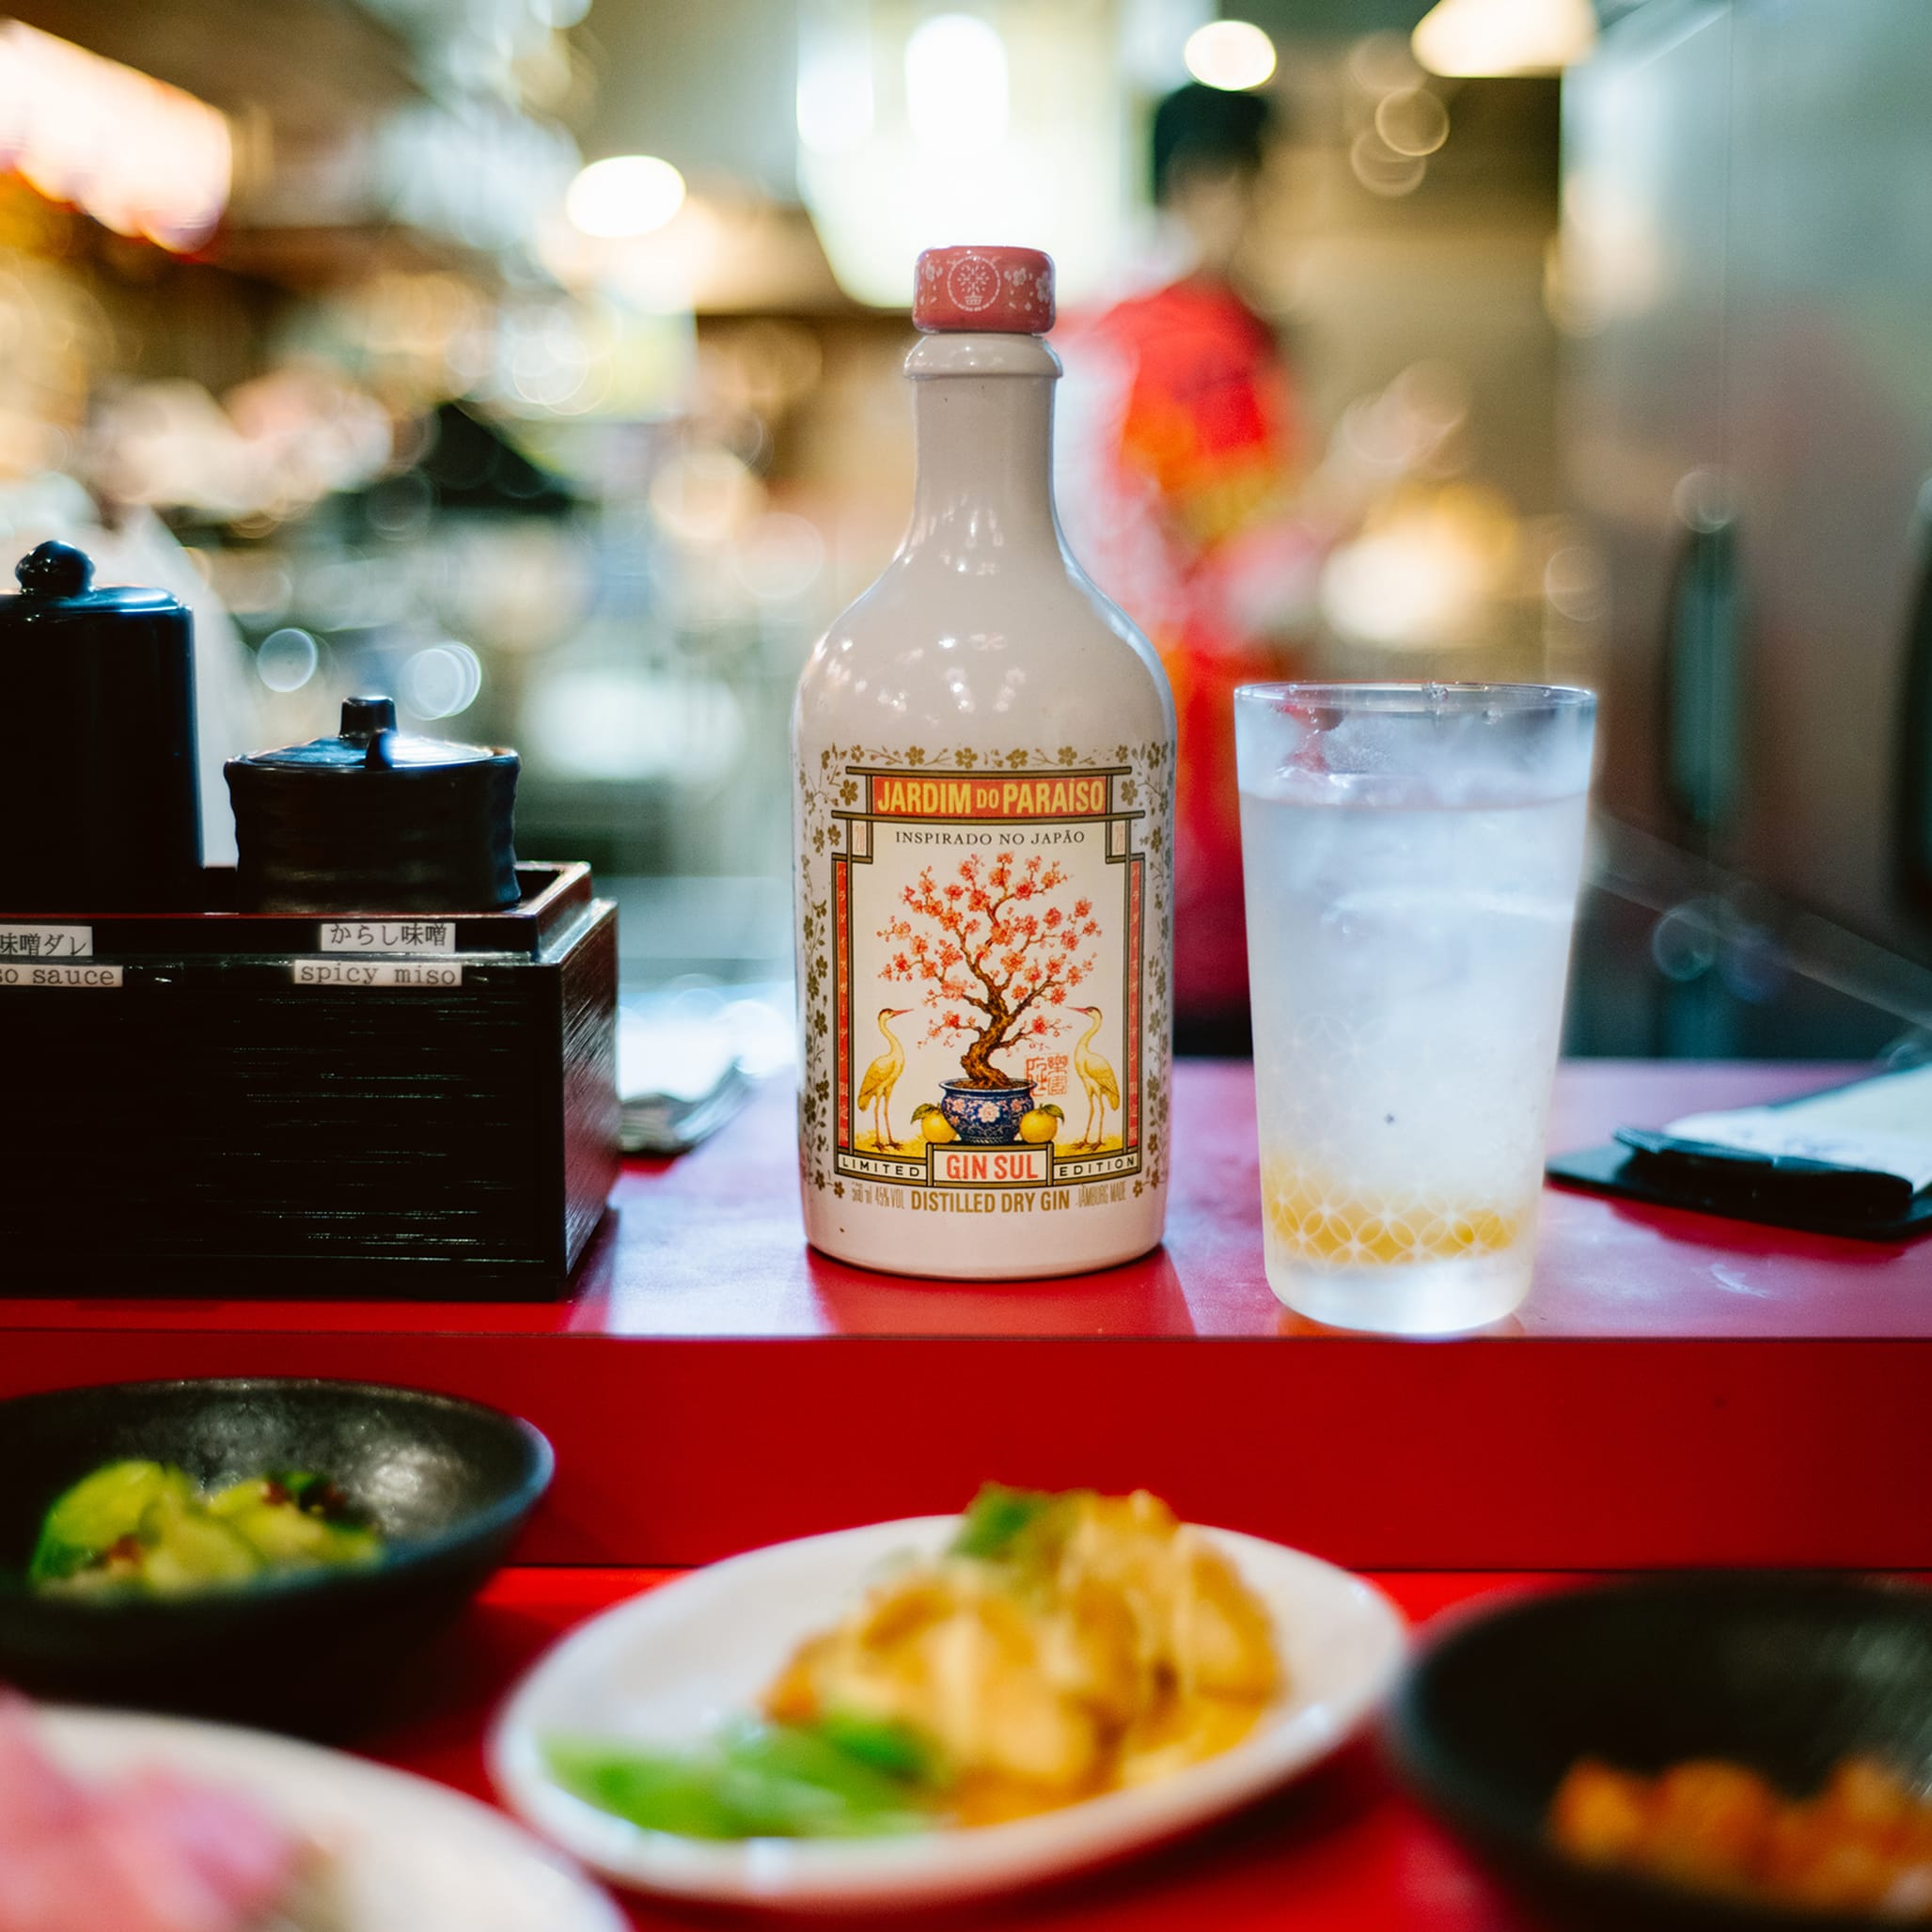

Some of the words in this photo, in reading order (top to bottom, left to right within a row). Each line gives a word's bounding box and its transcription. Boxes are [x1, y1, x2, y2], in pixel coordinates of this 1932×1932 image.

[877, 781, 972, 814] JARDIM
[976, 788, 999, 809] DO
[1002, 778, 1105, 814] PARAÍSO
[895, 831, 993, 846] INSPIRADO
[998, 833, 1026, 846] NO
[1030, 829, 1086, 845] JAPÃO
[330, 923, 447, 947] からし味噌
[0, 968, 19, 984] o
[32, 968, 115, 986] sauce
[301, 963, 379, 984] spicy
[395, 965, 456, 985] miso
[841, 1156, 920, 1177] LIMITED
[946, 1154, 988, 1180] GIN
[993, 1154, 1039, 1180] SUL
[1059, 1155, 1135, 1177] EDITION
[911, 1190, 996, 1214] DISTILLED
[1000, 1192, 1037, 1214] DRY
[1041, 1189, 1071, 1211] GIN
